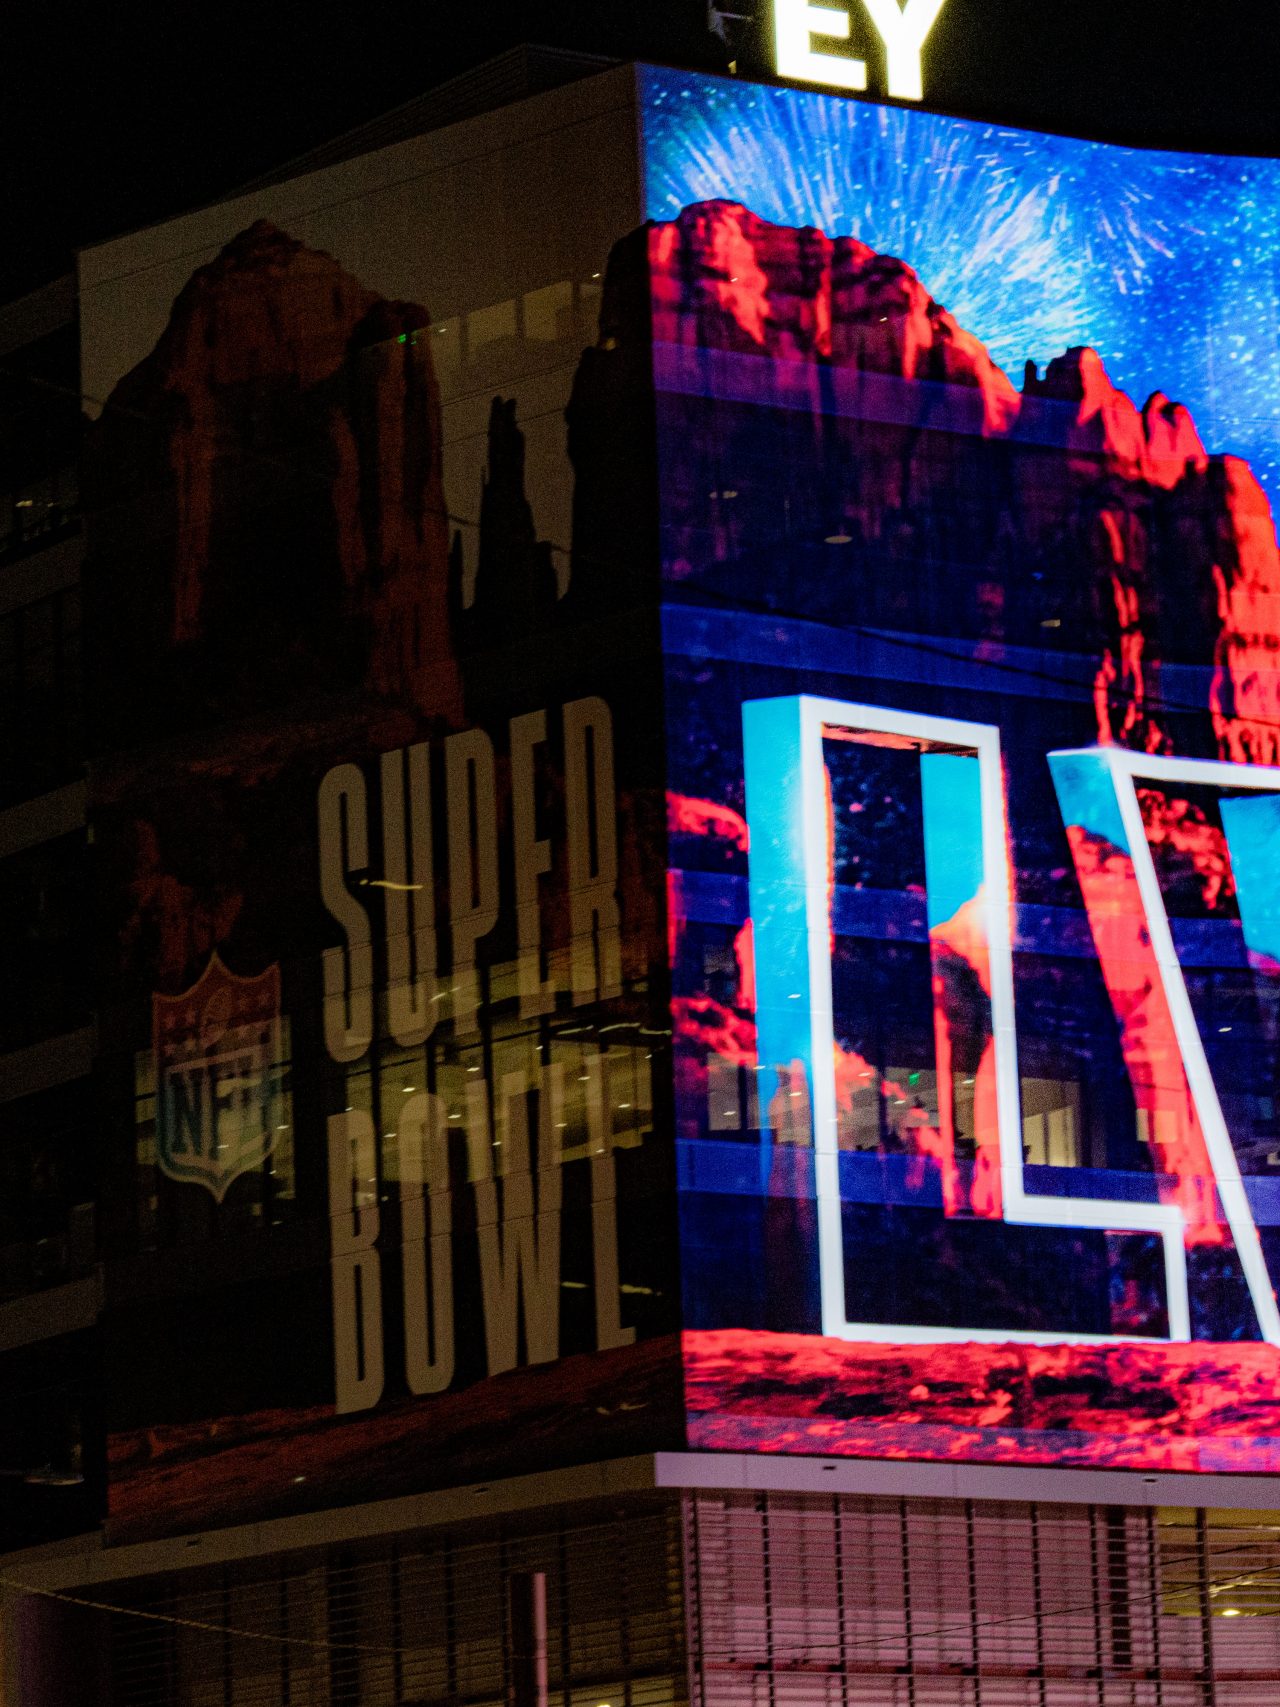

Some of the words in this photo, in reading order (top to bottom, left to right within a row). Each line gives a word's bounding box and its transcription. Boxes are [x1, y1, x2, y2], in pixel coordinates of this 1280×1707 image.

[774, 0, 946, 101] EY
[318, 695, 624, 1063] SUPER
[326, 1050, 637, 1415] BOWL
